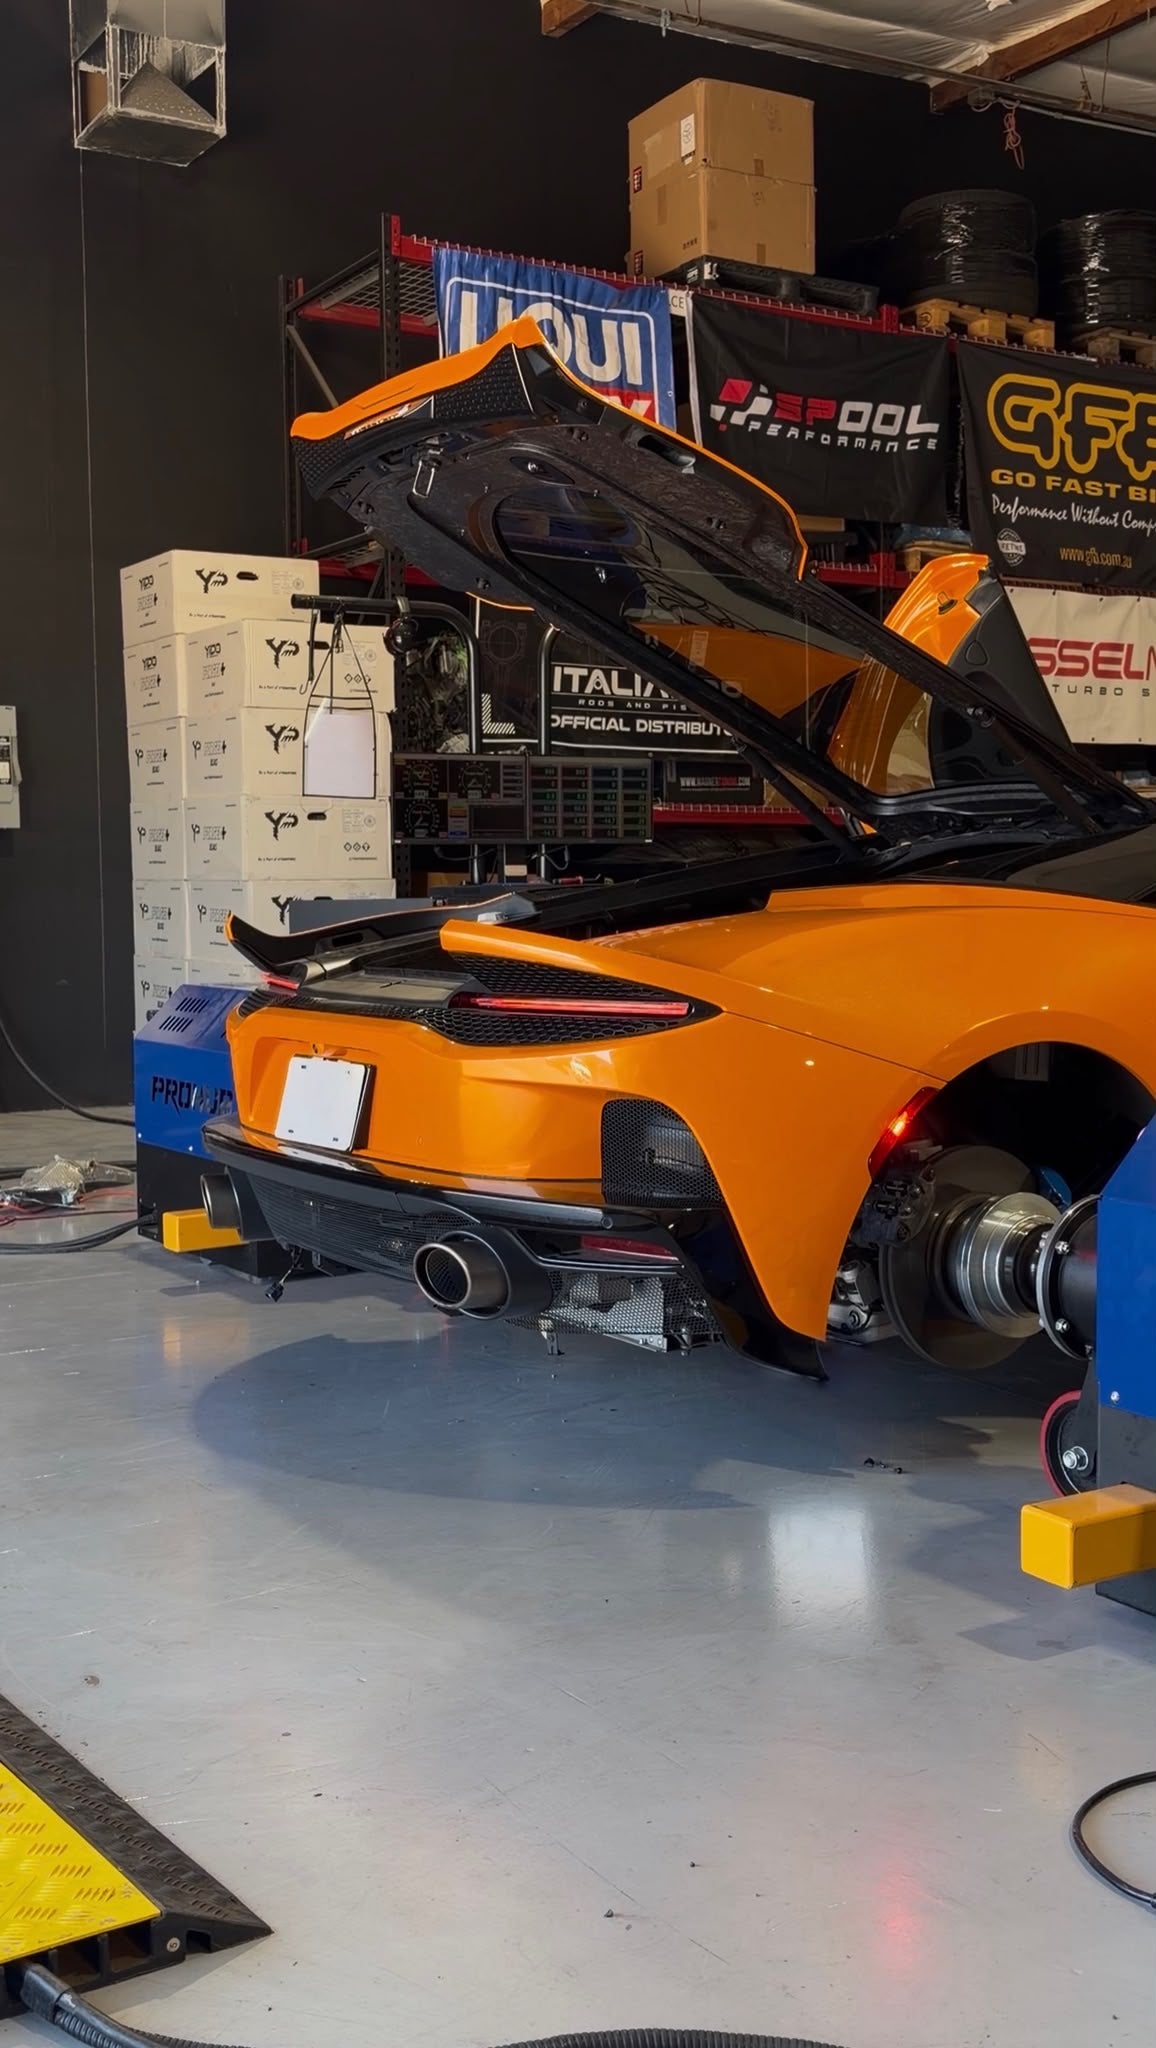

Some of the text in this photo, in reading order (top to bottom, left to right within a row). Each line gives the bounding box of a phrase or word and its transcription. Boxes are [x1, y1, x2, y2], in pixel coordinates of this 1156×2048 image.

[774, 392, 940, 436] SPOOL
[748, 420, 938, 452] PERFORMANCE
[991, 468, 1036, 488] GO
[1046, 475, 1122, 499] FAST
[992, 493, 1068, 523] Performance
[1071, 502, 1119, 527] Without
[1060, 547, 1132, 568] www.gfb.com.au
[1052, 684, 1123, 696] TURBO
[578, 698, 688, 711] RODS AND PIS
[551, 713, 631, 733] OFFICIAL
